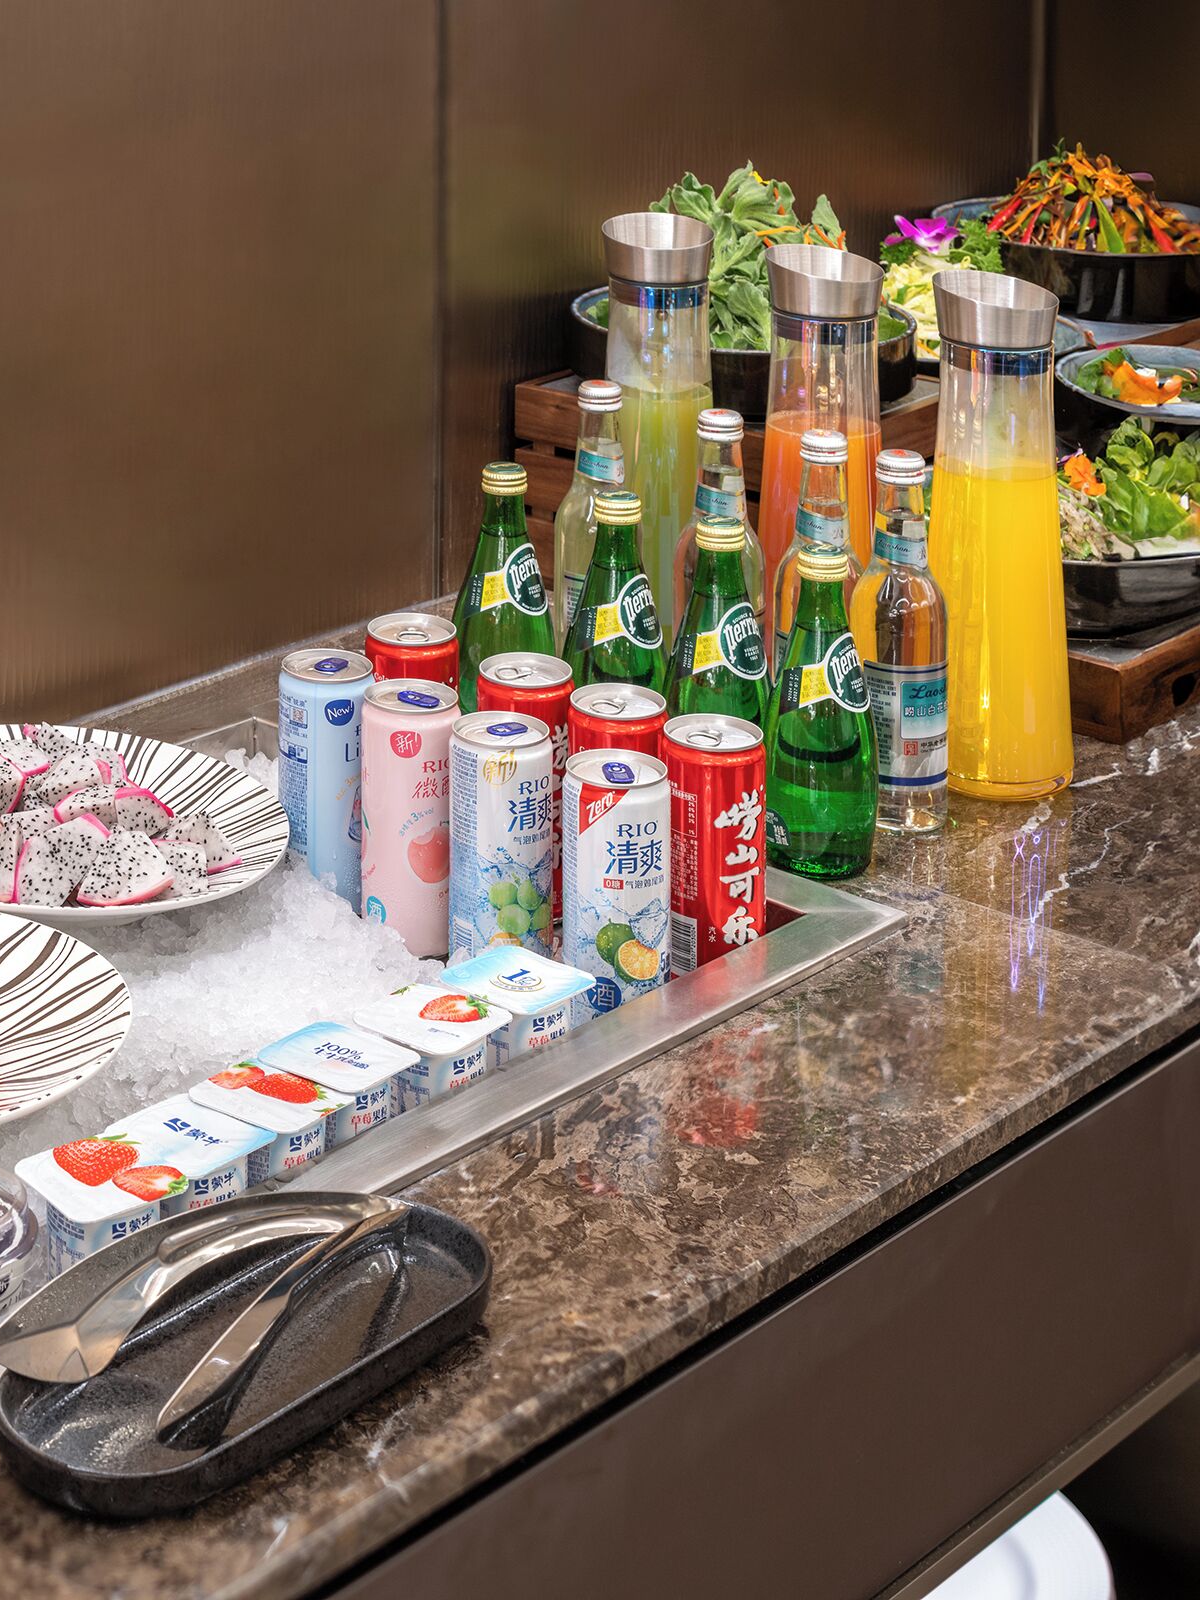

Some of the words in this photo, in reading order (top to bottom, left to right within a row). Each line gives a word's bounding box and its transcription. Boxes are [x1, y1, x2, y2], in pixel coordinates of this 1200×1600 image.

[326, 701, 354, 721] New!
[396, 732, 420, 754] 新!
[518, 775, 550, 796] RIO
[507, 793, 552, 833] 清爽
[586, 791, 614, 825] Zero
[616, 821, 657, 839] RIO
[604, 839, 663, 877] 清爽
[591, 982, 615, 1008] 酒
[322, 1042, 364, 1060] 100%
